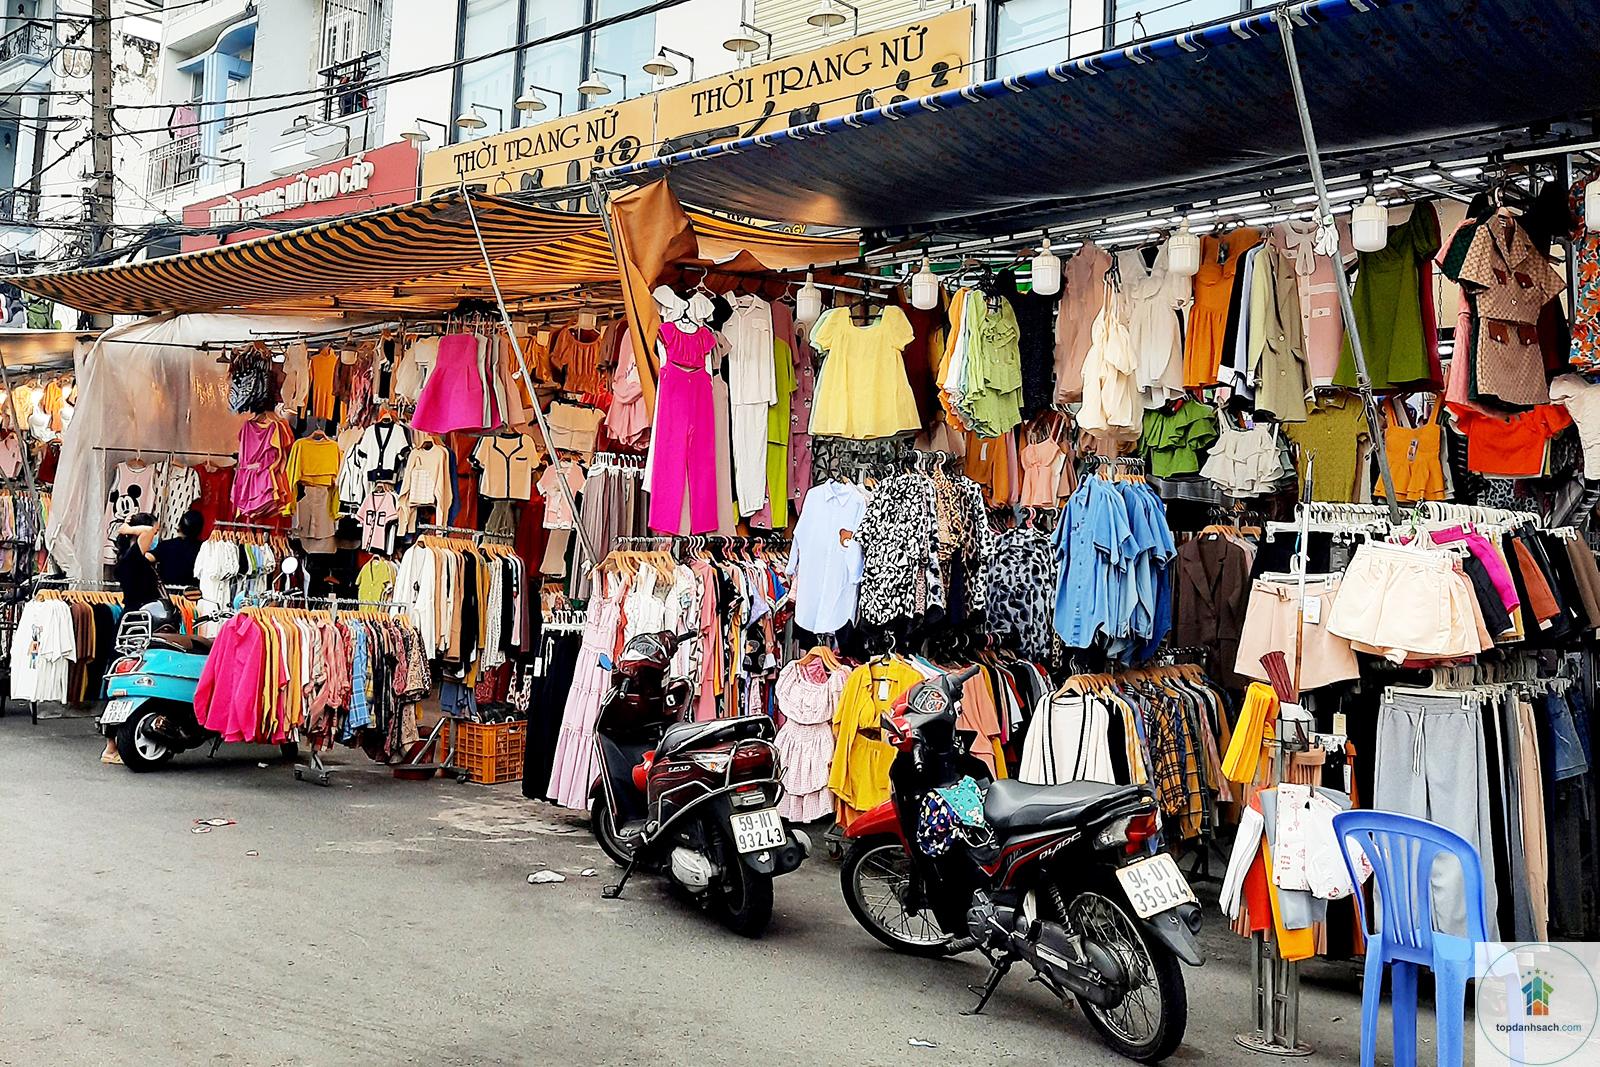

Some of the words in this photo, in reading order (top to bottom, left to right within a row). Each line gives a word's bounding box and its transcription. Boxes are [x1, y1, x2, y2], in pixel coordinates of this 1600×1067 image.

[691, 74, 754, 117] THỜI
[762, 45, 873, 98] TRANG
[880, 25, 929, 68] NỮ
[453, 141, 498, 175] THỜI
[504, 124, 581, 163] TRANG
[586, 108, 619, 143] NỮ
[307, 171, 339, 202] CAO
[339, 152, 374, 194] CẤP
[738, 812, 773, 831] 59-N1
[738, 828, 783, 850] 932.43
[1133, 879, 1188, 912] 359.44
